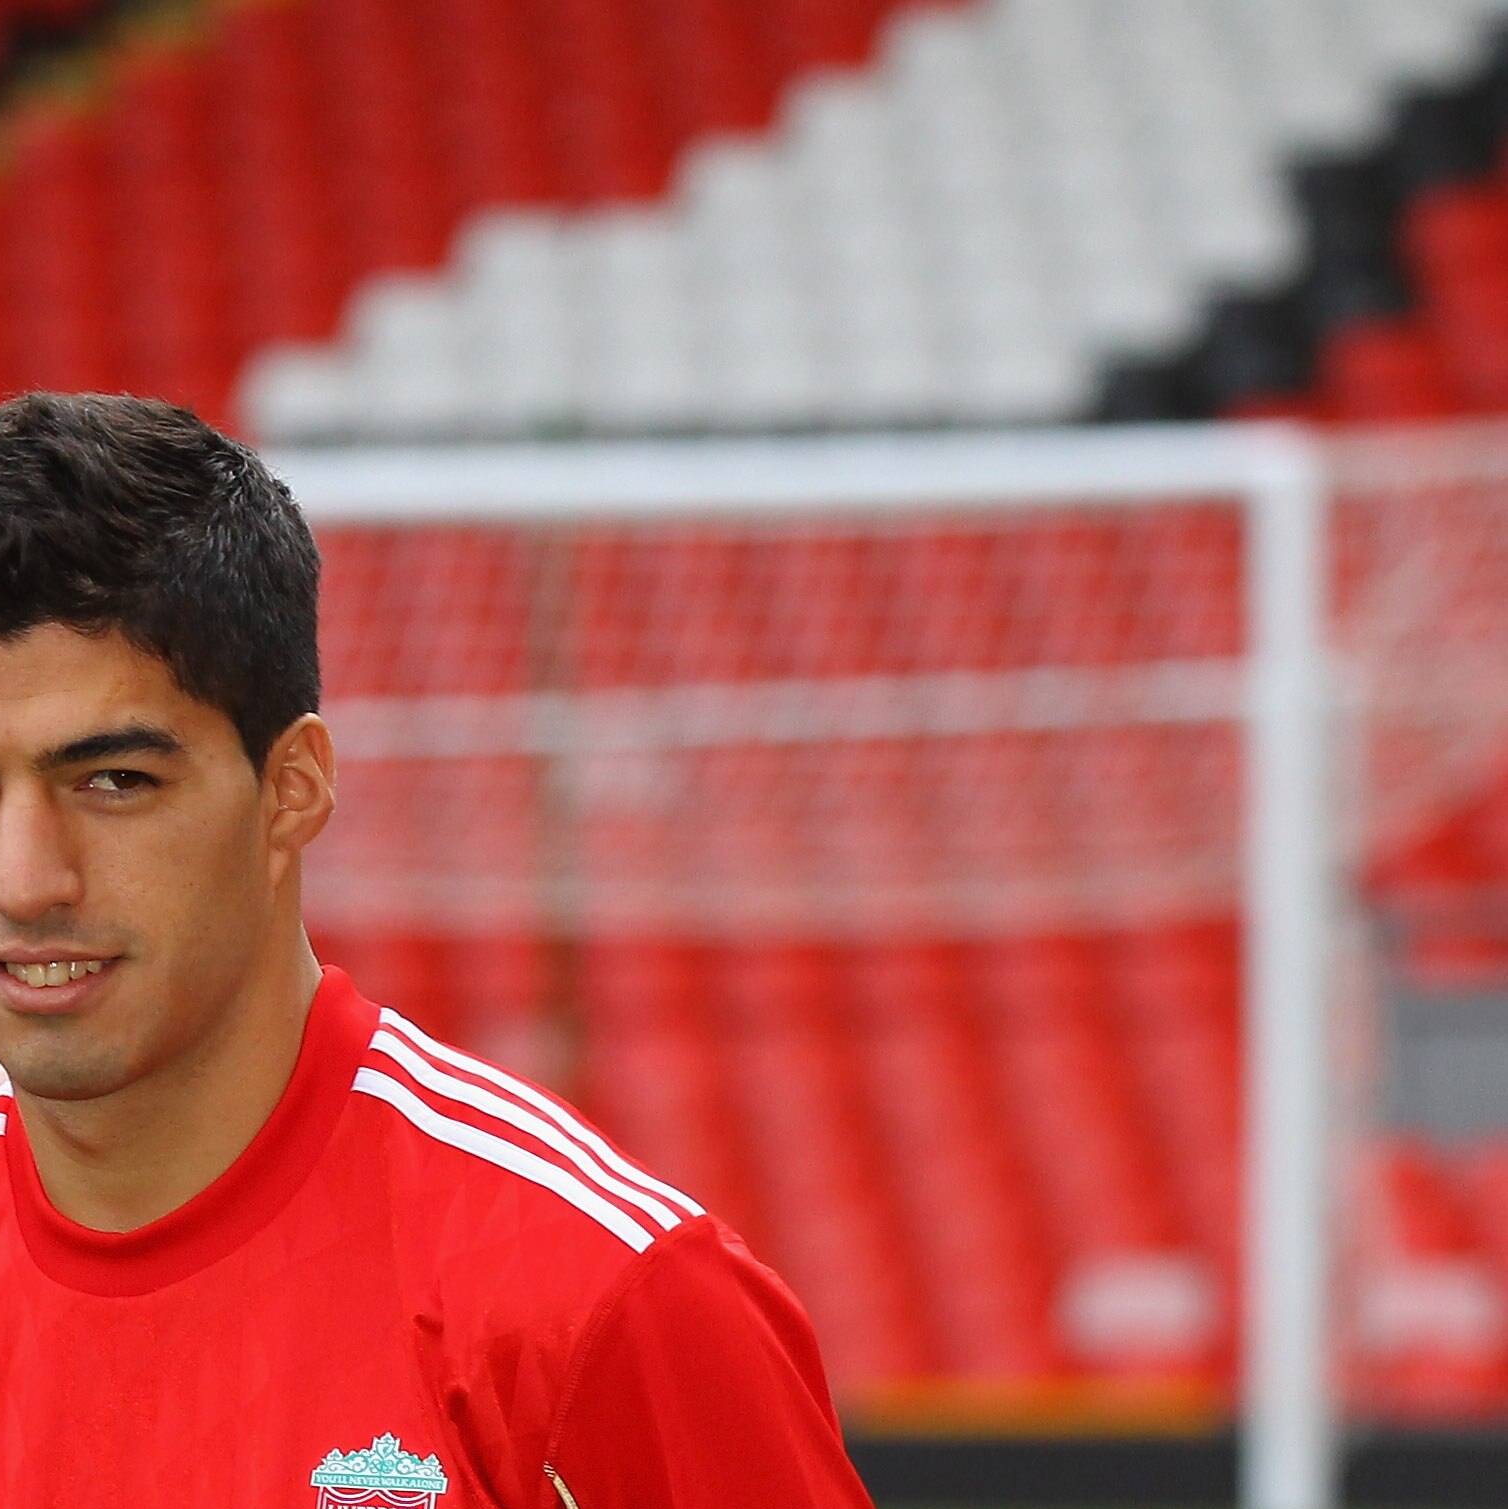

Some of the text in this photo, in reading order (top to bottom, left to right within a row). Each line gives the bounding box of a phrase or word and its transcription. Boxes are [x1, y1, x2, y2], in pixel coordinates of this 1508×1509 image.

[348, 1475, 381, 1486] NEVER
[381, 1477, 409, 1488] WALK
[408, 1478, 443, 1489] ALONE
